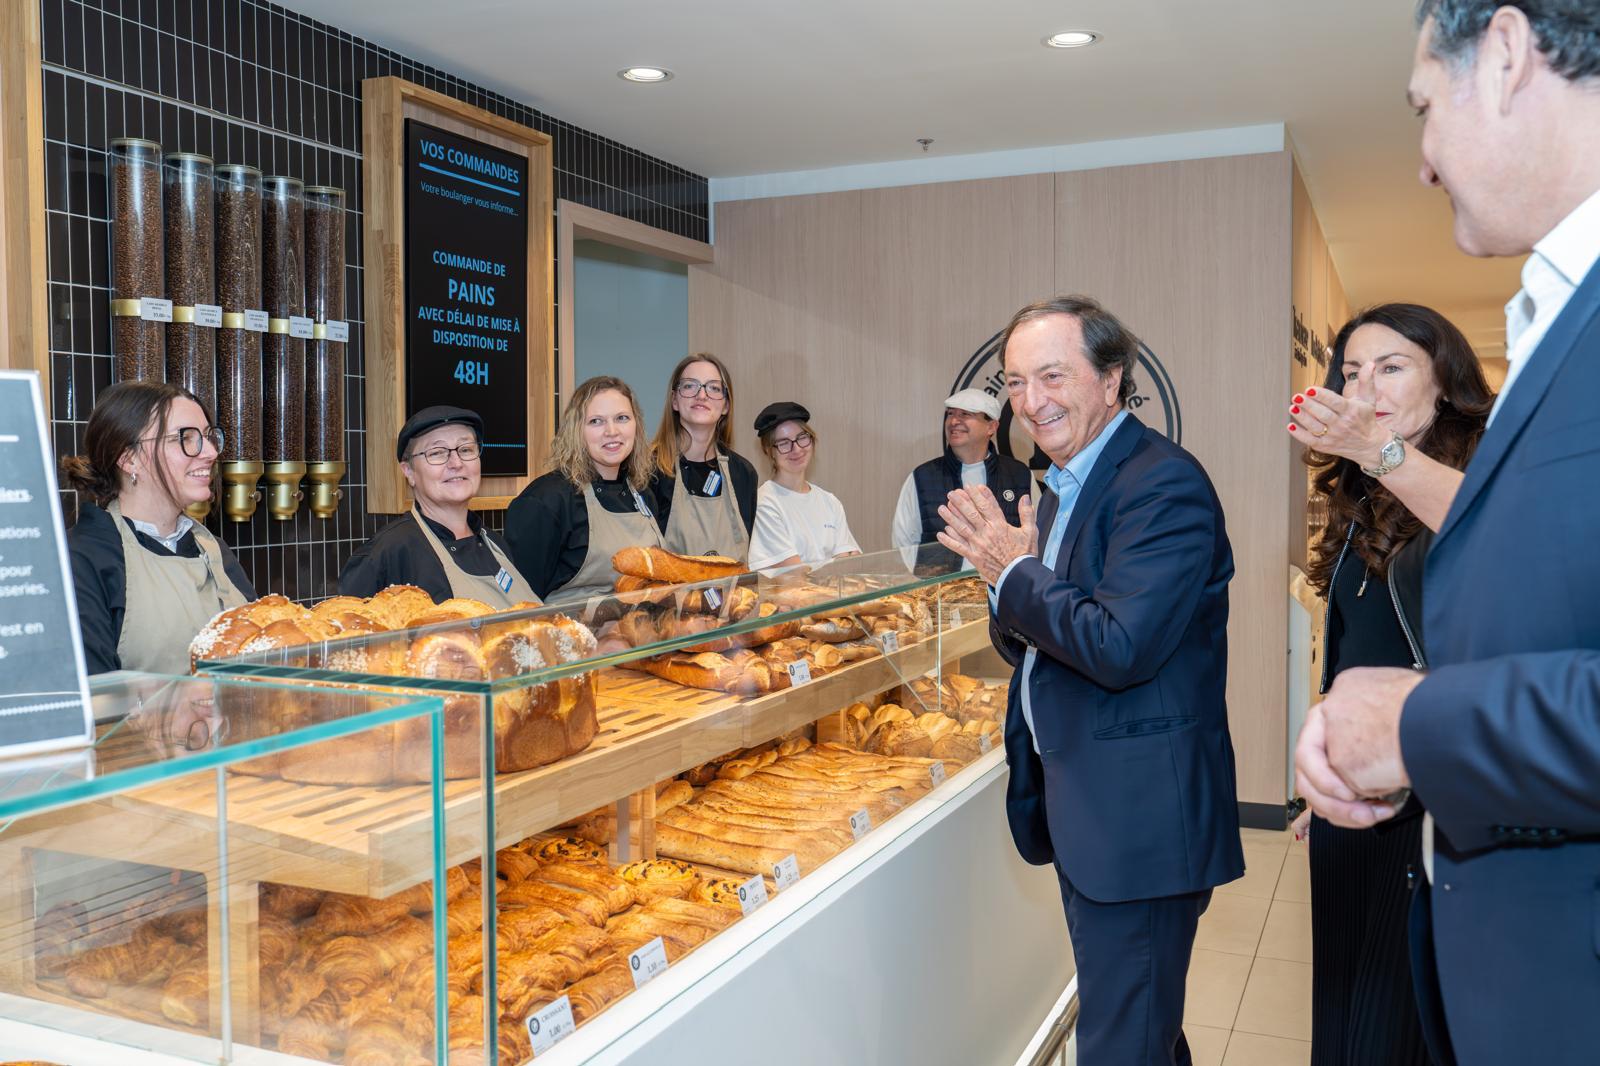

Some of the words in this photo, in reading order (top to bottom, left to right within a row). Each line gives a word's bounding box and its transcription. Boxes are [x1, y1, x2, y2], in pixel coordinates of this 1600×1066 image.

[420, 139, 445, 160] VOS
[447, 148, 519, 184] COMMANDES
[420, 180, 441, 195] Votre
[440, 186, 474, 204] boulanger
[474, 197, 490, 209] vous
[432, 250, 492, 274] COMMANDE
[493, 262, 506, 277] DE
[448, 278, 496, 306] PAINS
[417, 306, 445, 322] AVEC
[446, 308, 475, 326] DÉLAI
[476, 314, 489, 329] DE
[490, 316, 512, 332] MISE
[513, 317, 521, 333] À
[433, 329, 494, 350] DISPOSITION
[496, 337, 508, 352] DE
[453, 359, 490, 386] 48H
[0, 525, 41, 540] ations
[24, 622, 45, 635] en
